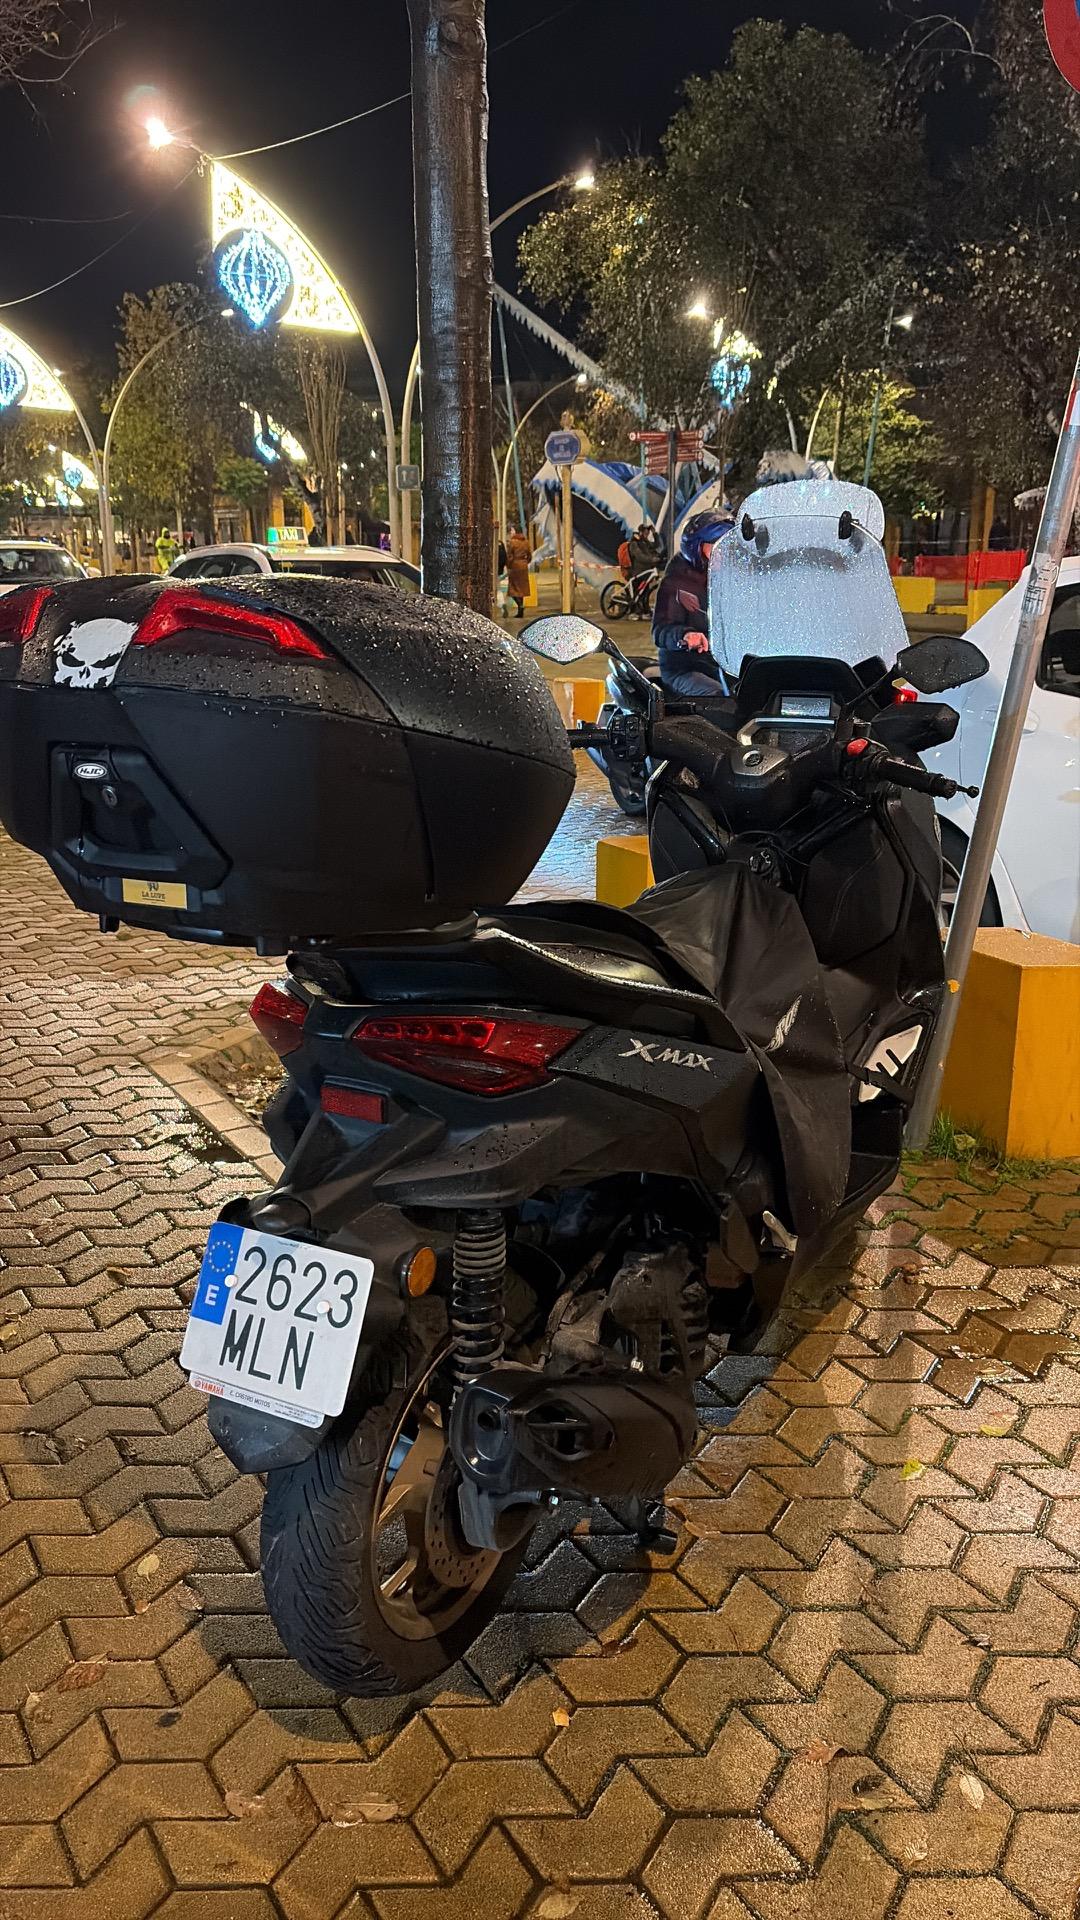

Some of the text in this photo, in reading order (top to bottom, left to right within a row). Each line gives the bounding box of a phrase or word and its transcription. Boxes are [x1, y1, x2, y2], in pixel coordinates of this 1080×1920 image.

[277, 528, 299, 541] TAXI
[204, 1283, 220, 1306] E
[235, 1246, 358, 1329] 2623
[219, 1308, 315, 1390] MLN
[201, 1380, 225, 1397] YAMAHA
